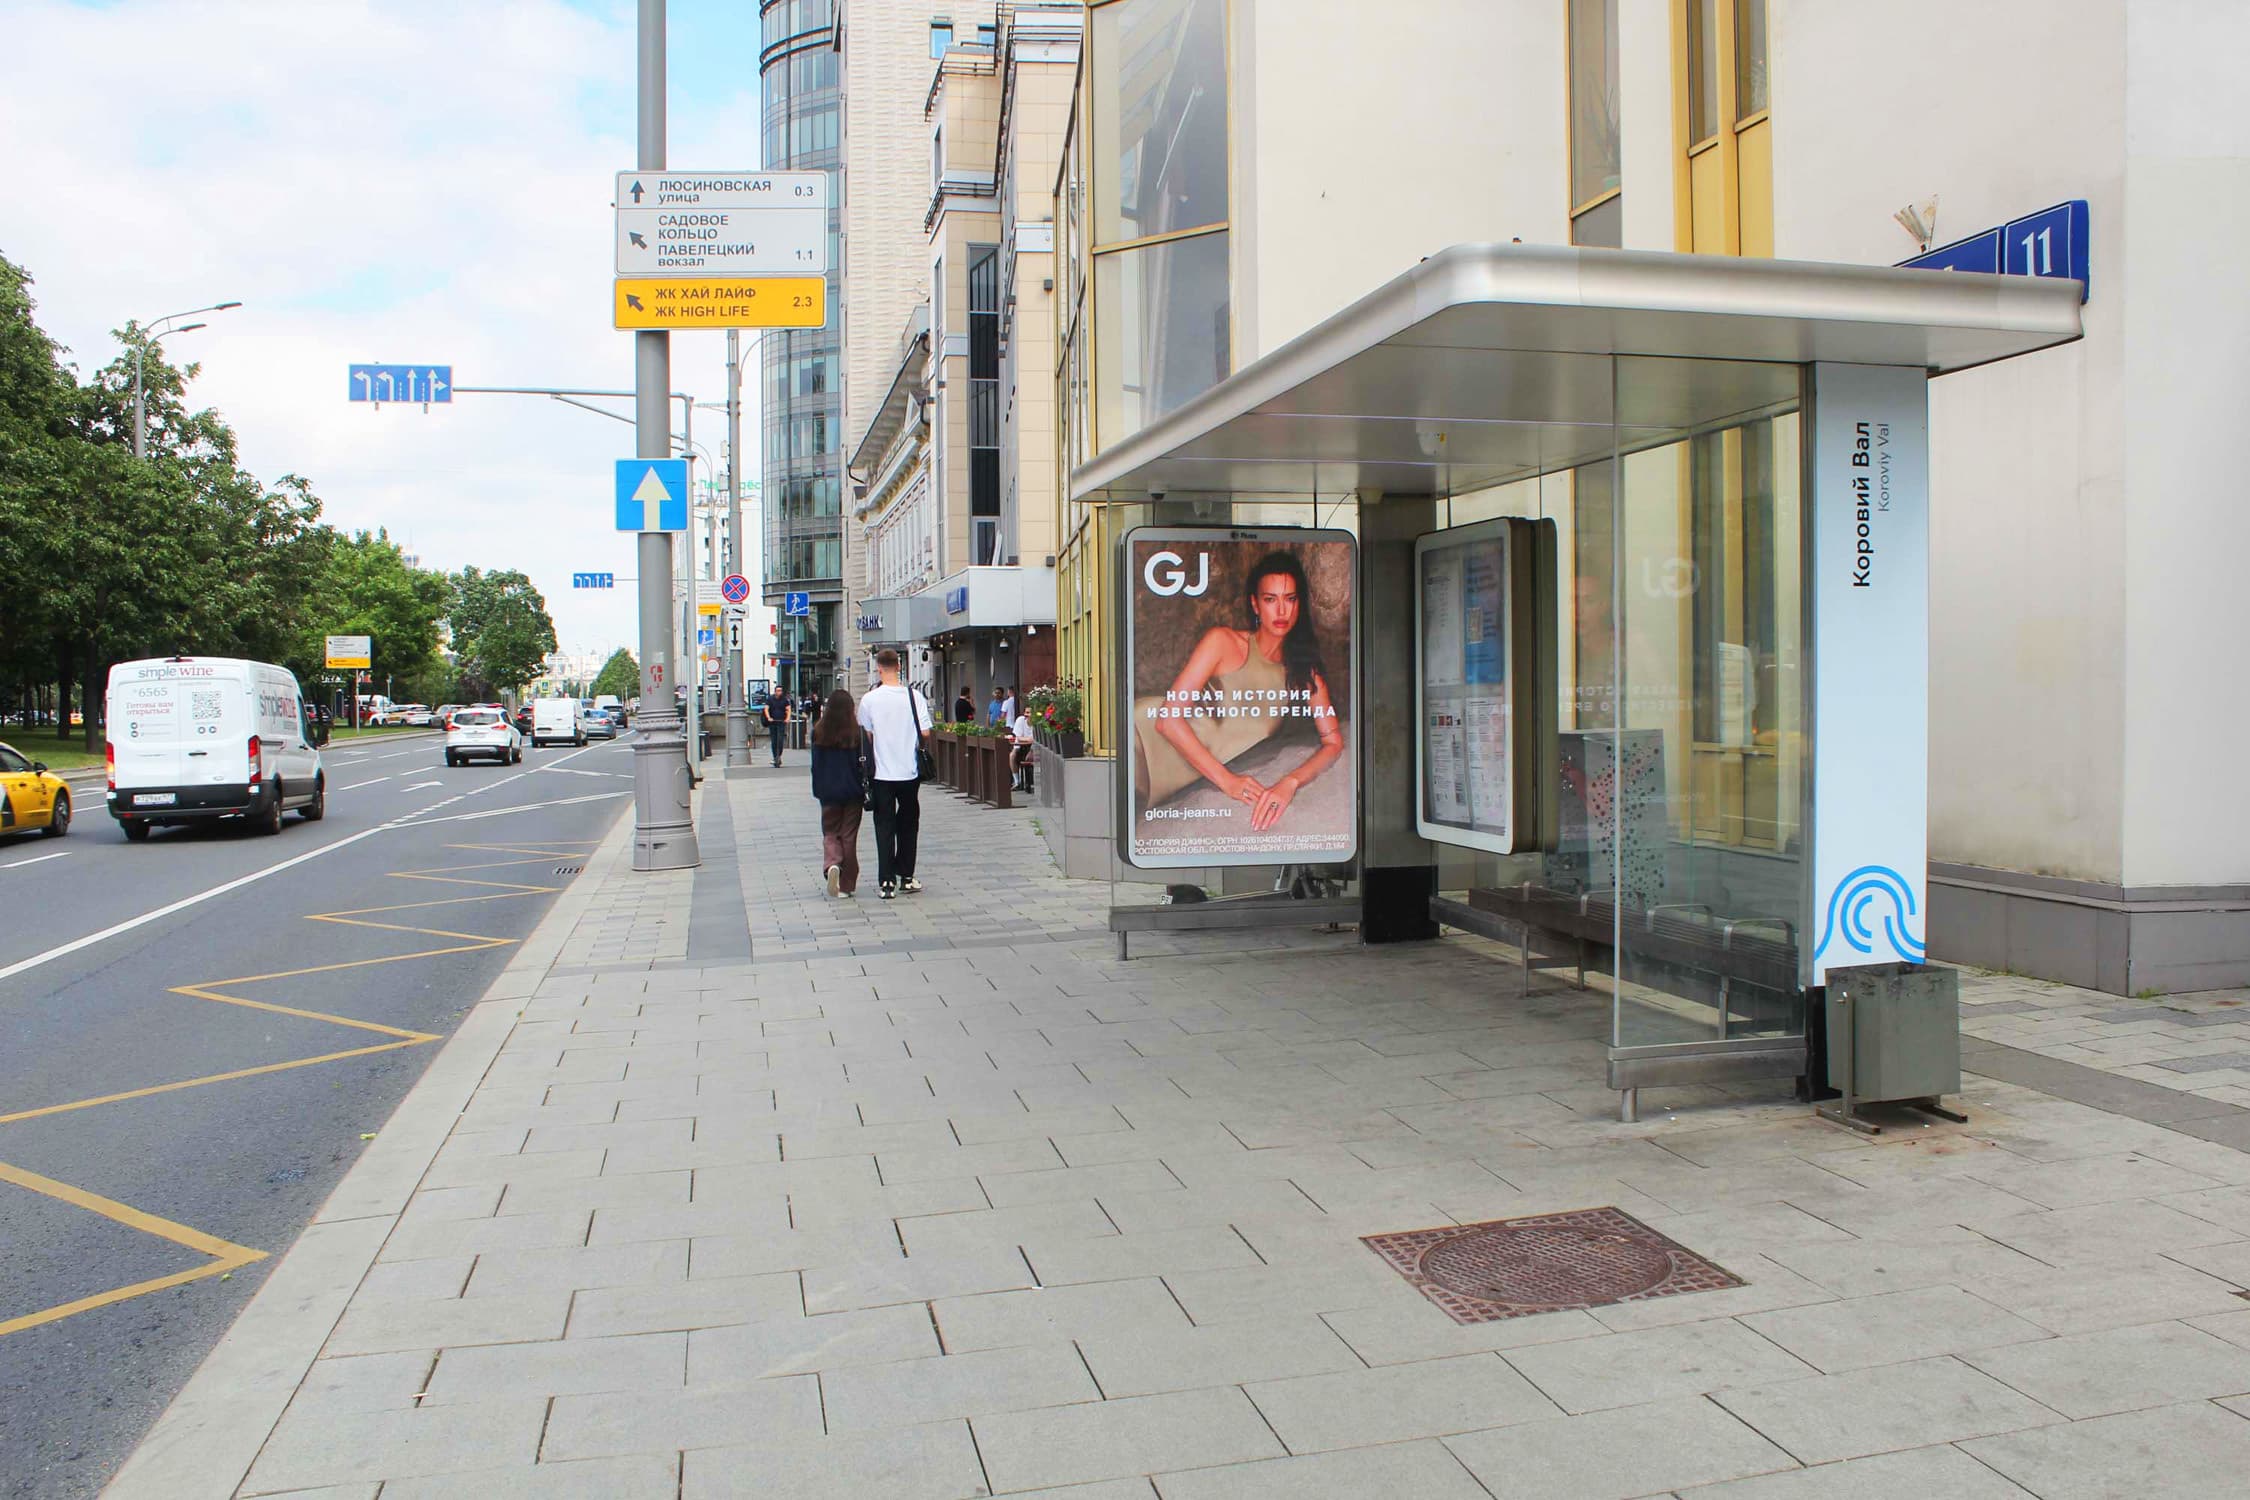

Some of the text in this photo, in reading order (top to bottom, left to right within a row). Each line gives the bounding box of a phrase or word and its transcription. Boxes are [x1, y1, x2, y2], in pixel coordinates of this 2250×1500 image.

[658, 180, 772, 192] ЛЮСИНОВСКАЯ
[794, 186, 814, 197] 0.3
[658, 193, 700, 205] улица
[658, 215, 729, 227] САДОВОЕ
[658, 228, 718, 241] КОЛЬЦО
[658, 243, 755, 257] ПАВЕЛЕЦКИЙ
[795, 250, 814, 260] 1.1
[2021, 226, 2052, 277] 11
[658, 258, 705, 267] вокзал
[656, 285, 757, 299] ЖК ХАЙ ЛАЙФ
[793, 296, 813, 308] 2.3
[656, 306, 750, 317] ЖК HIGH LIFE
[1877, 423, 1891, 512] Koroviy Val
[1852, 422, 1875, 587] Коровий Вал
[1144, 551, 1209, 597] GJ
[1166, 689, 1311, 702] НОВАЯ ИСТОРИЯ
[1147, 705, 1337, 719] ИЗВЕСТНОГО БРЕНДА
[1145, 807, 1232, 821] gloria-jeans.ru
